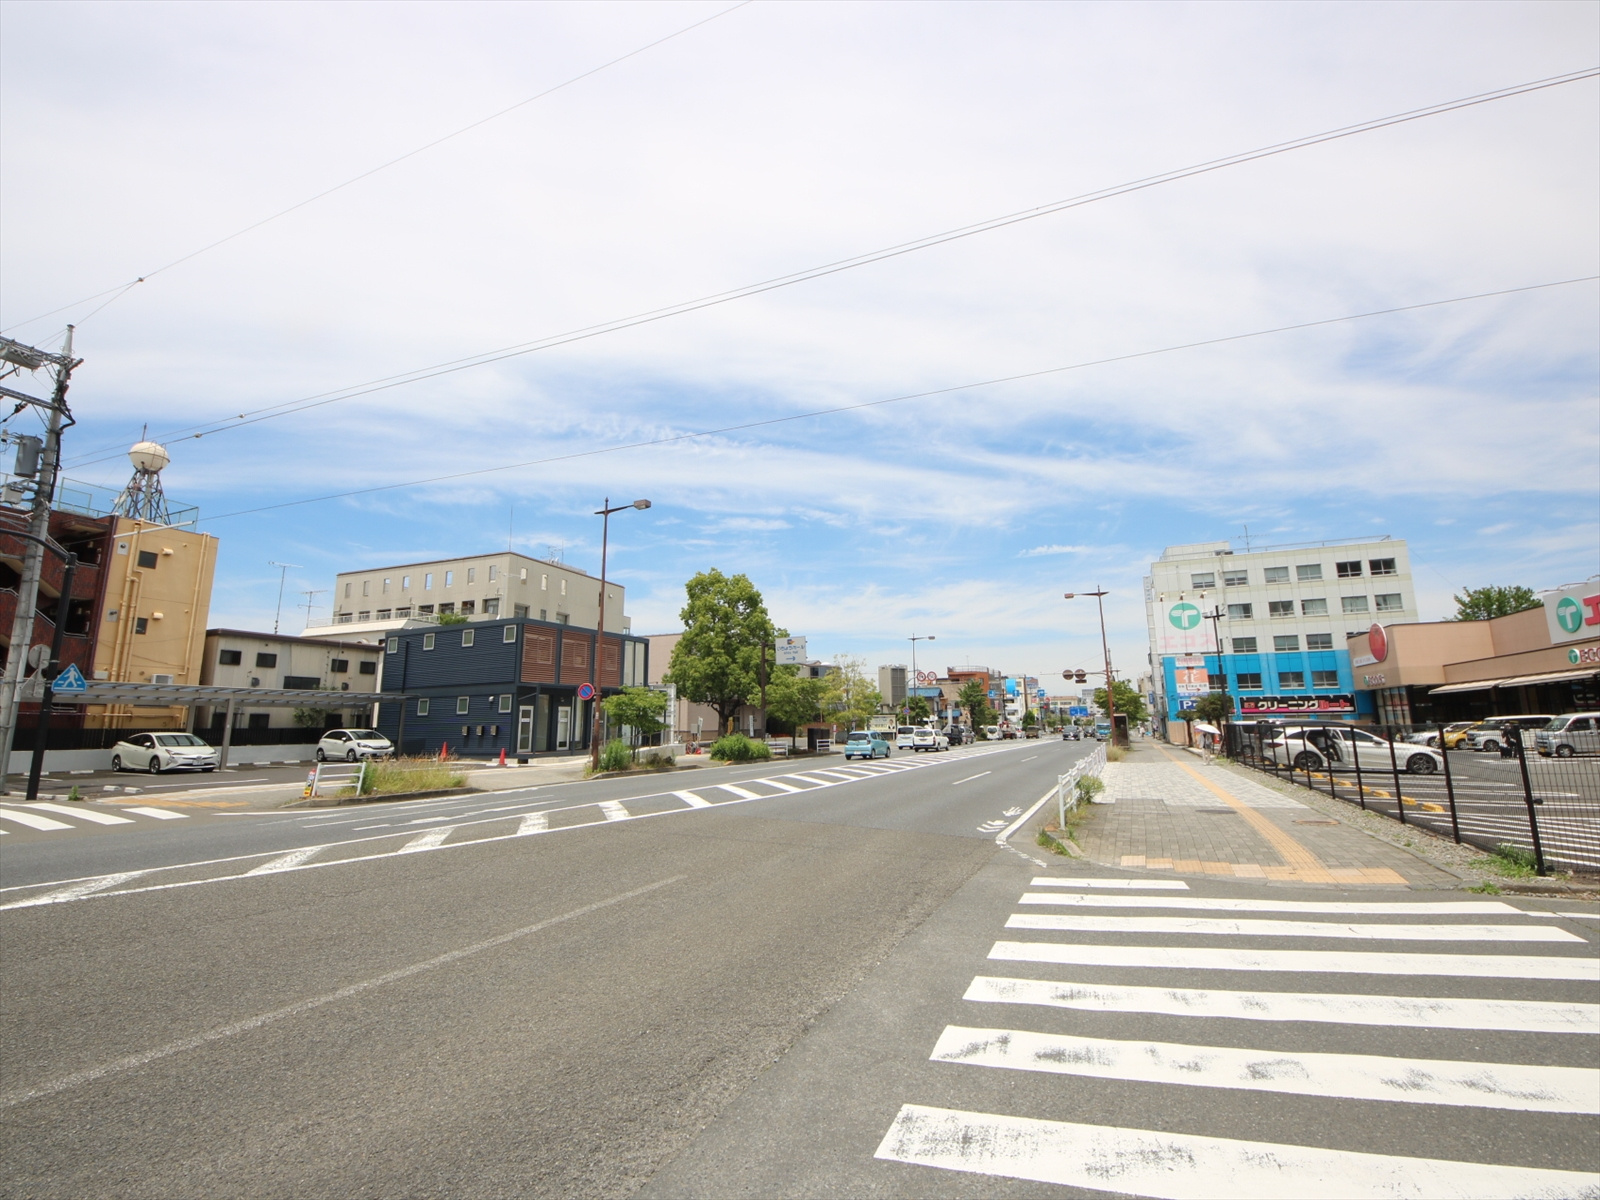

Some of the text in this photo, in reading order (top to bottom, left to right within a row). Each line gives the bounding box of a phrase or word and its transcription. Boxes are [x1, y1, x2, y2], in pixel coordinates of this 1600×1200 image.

[1159, 633, 1217, 649] エコス
[1183, 701, 1192, 709] P
